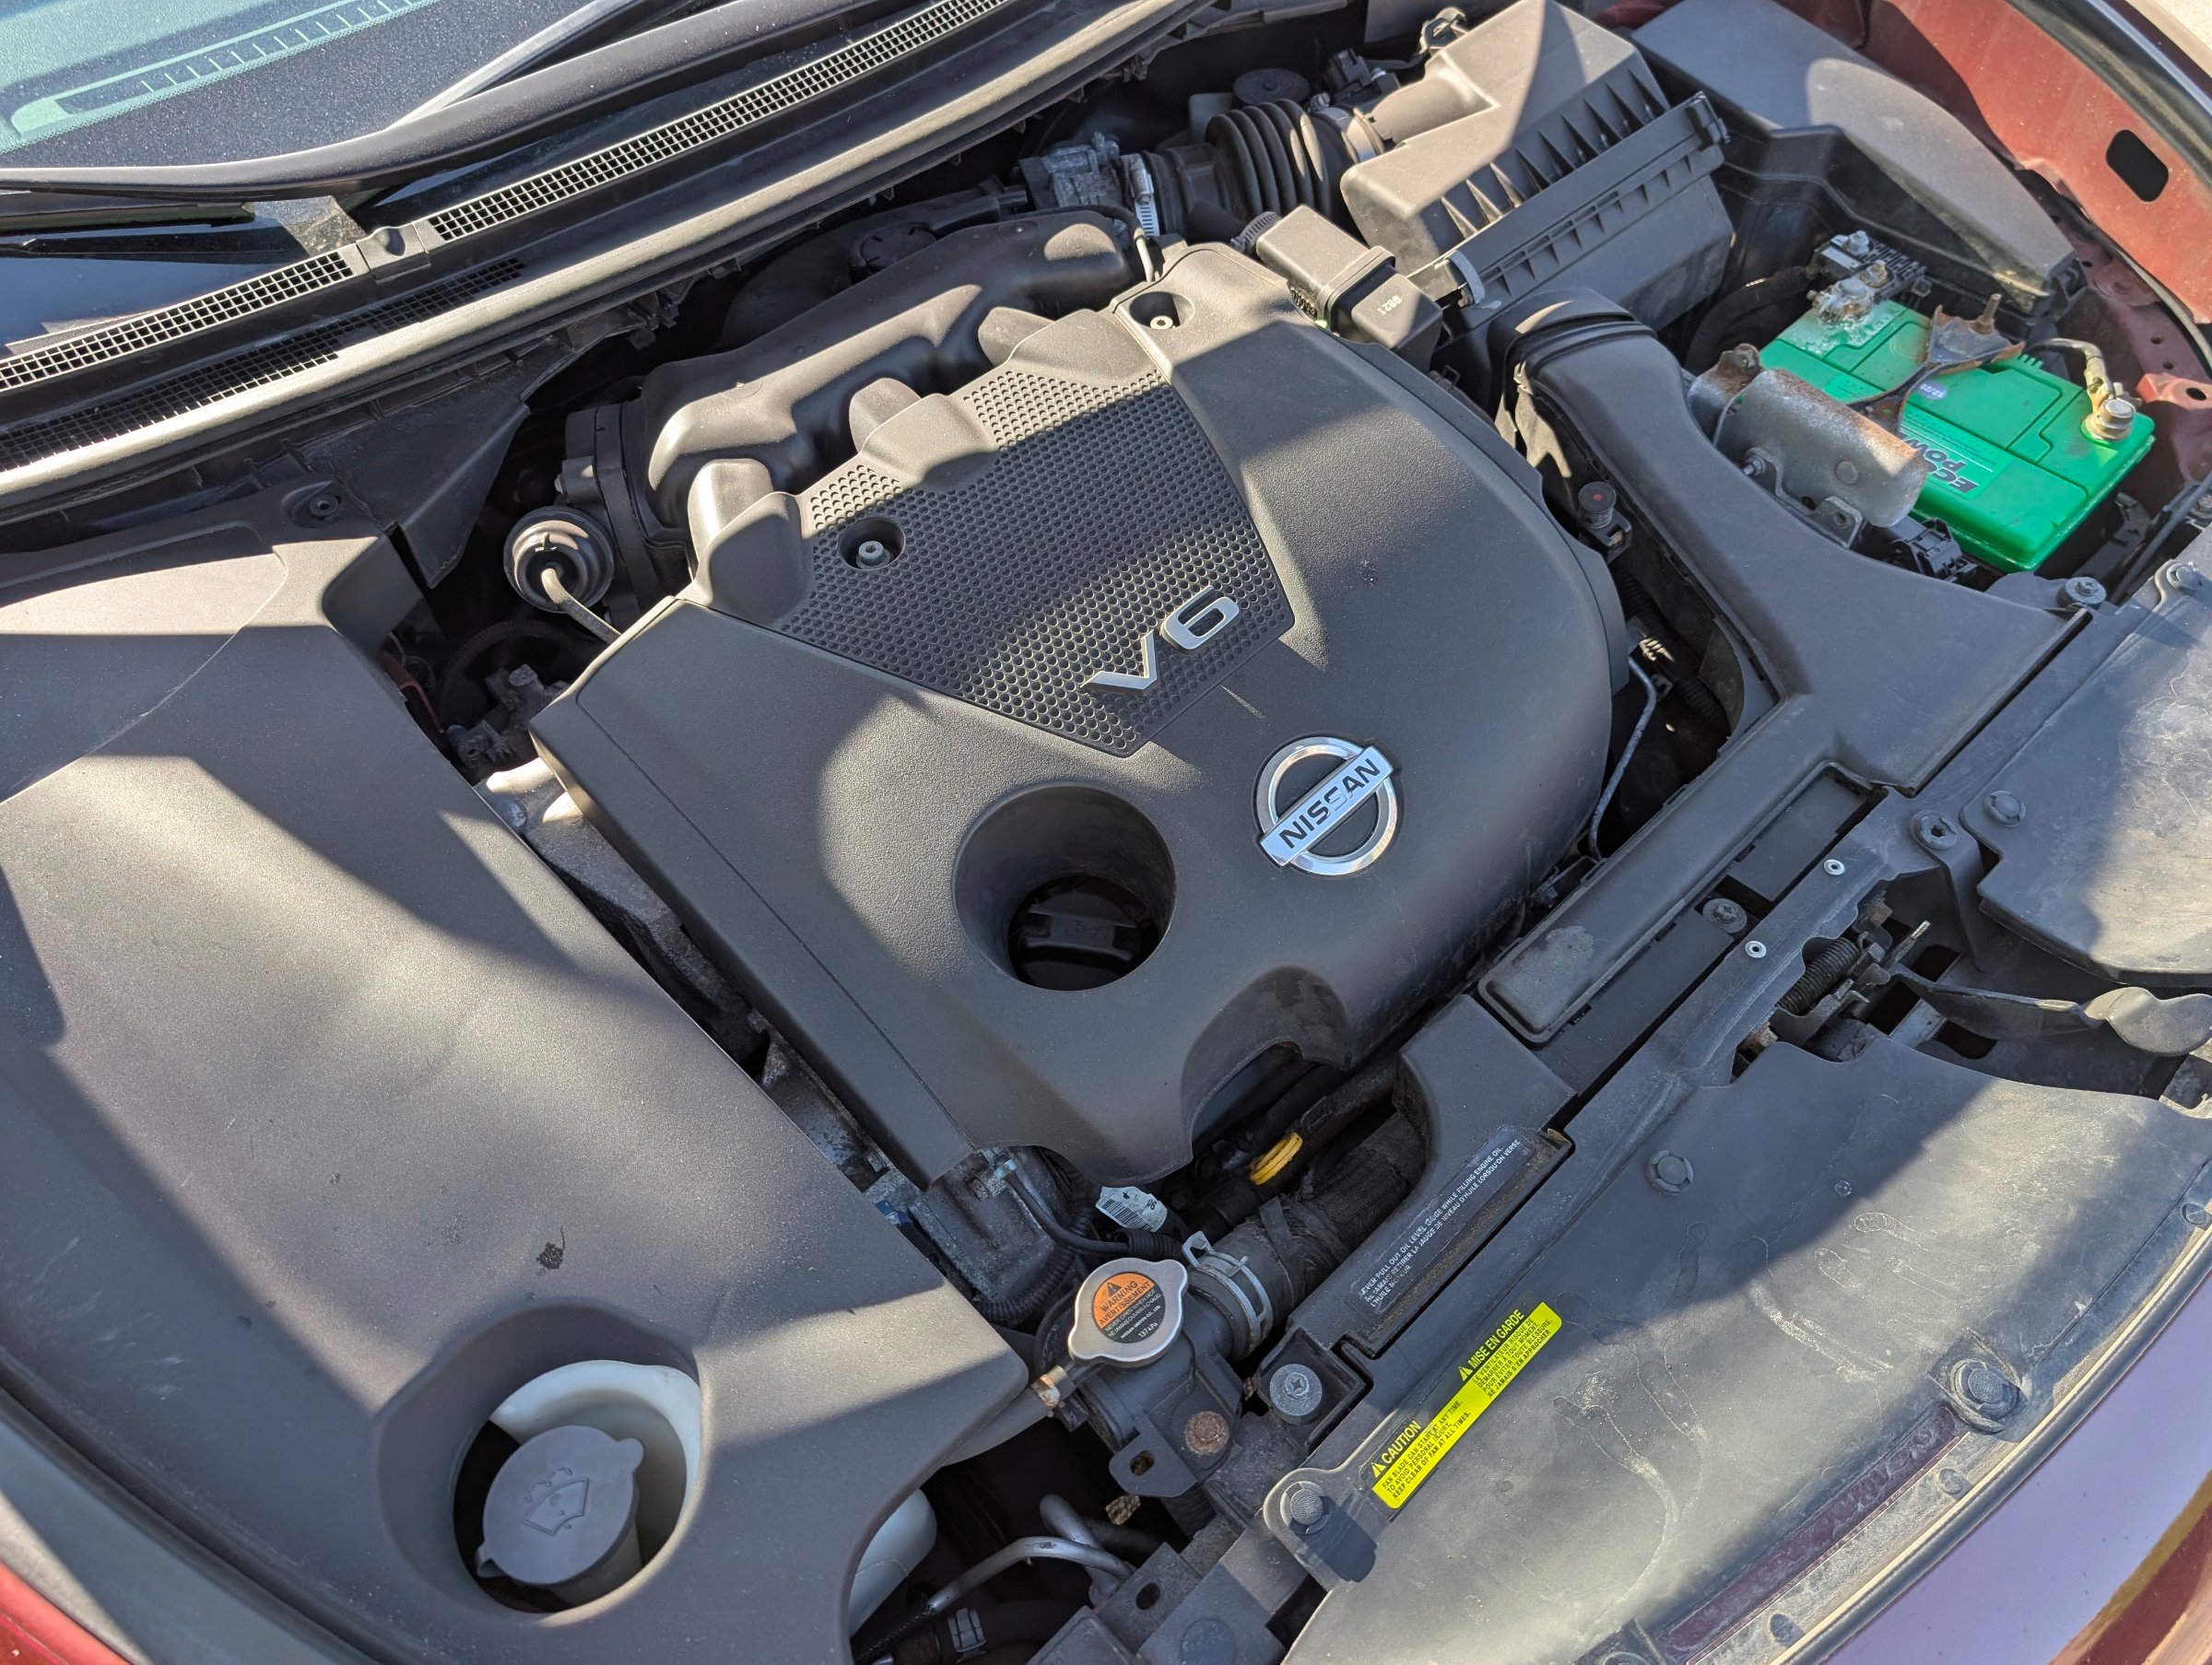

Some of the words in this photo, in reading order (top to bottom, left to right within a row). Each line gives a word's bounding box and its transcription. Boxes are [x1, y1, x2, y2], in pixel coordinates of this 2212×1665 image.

[1080, 584, 1240, 691] V6
[1278, 757, 1381, 850] NISSAN
[1375, 1263, 1390, 1279] PULL
[1387, 1251, 1401, 1265] OUT
[1398, 1241, 1410, 1253] OIL
[1440, 1191, 1458, 1209] WHILE
[1455, 1173, 1476, 1193] FILLING
[1474, 1155, 1494, 1175] ENGINE
[1491, 1144, 1503, 1156] OIL.
[1390, 1251, 1413, 1275] RETIRER
[1410, 1244, 1419, 1253] LA
[1433, 1219, 1442, 1229] DE
[1441, 1201, 1461, 1221] NIVEAU
[1458, 1181, 1479, 1202] D'HUILE
[1477, 1154, 1505, 1183] LORSQU'ON
[1502, 1138, 1520, 1156] VERSE
[1099, 1280, 1151, 1325] AVERTISSEMENT
[1100, 1279, 1137, 1312] WARNING
[1104, 1317, 1121, 1331] NEVER
[1145, 1288, 1156, 1298] HOT
[1113, 1318, 1129, 1332] JAMAIS
[1120, 1325, 1135, 1339] NISSAN
[1133, 1316, 1147, 1328] MOTOR
[1137, 1328, 1148, 1338] 137
[1147, 1320, 1158, 1331] kPa
[1467, 1344, 1490, 1369] MISE
[1485, 1333, 1500, 1351] EN
[1495, 1307, 1524, 1340] GARDE
[1472, 1374, 1480, 1383] LE
[1478, 1343, 1510, 1376] VENTILATEUR
[1508, 1324, 1526, 1344] RISQUE
[1524, 1317, 1534, 1326] DE
[1481, 1377, 1497, 1393] POUR
[1493, 1357, 1513, 1378] ÉVITER
[1512, 1343, 1528, 1361] TOUTE
[1526, 1317, 1552, 1345] BLESSURE,
[1500, 1354, 1508, 1362] À
[1505, 1342, 1520, 1356] TOUT
[1517, 1320, 1539, 1343] MOMENT.
[1486, 1388, 1496, 1398] NE
[1493, 1369, 1512, 1389] JAMAIS
[1511, 1357, 1524, 1371] S'EN
[1522, 1328, 1550, 1359] APPROCHER
[1381, 1419, 1421, 1465] CAUTION
[1382, 1475, 1393, 1489] FAN
[1391, 1458, 1408, 1478] BLADE
[1406, 1446, 1419, 1460] CAN
[1418, 1428, 1435, 1448] START
[1431, 1423, 1440, 1433] AT
[1438, 1413, 1450, 1425] ANY
[1447, 1398, 1463, 1415] TIME.
[1386, 1483, 1395, 1494] TO
[1394, 1466, 1410, 1485] AVOID
[1408, 1439, 1434, 1469] PERSONAL
[1392, 1482, 1406, 1499] KEEP
[1405, 1463, 1422, 1484] CLEAR
[1420, 1456, 1430, 1466] OF
[1428, 1445, 1439, 1458] FAN
[1437, 1437, 1445, 1448] AT
[1443, 1426, 1455, 1440] ALL
[1453, 1409, 1471, 1429] TIMES.
